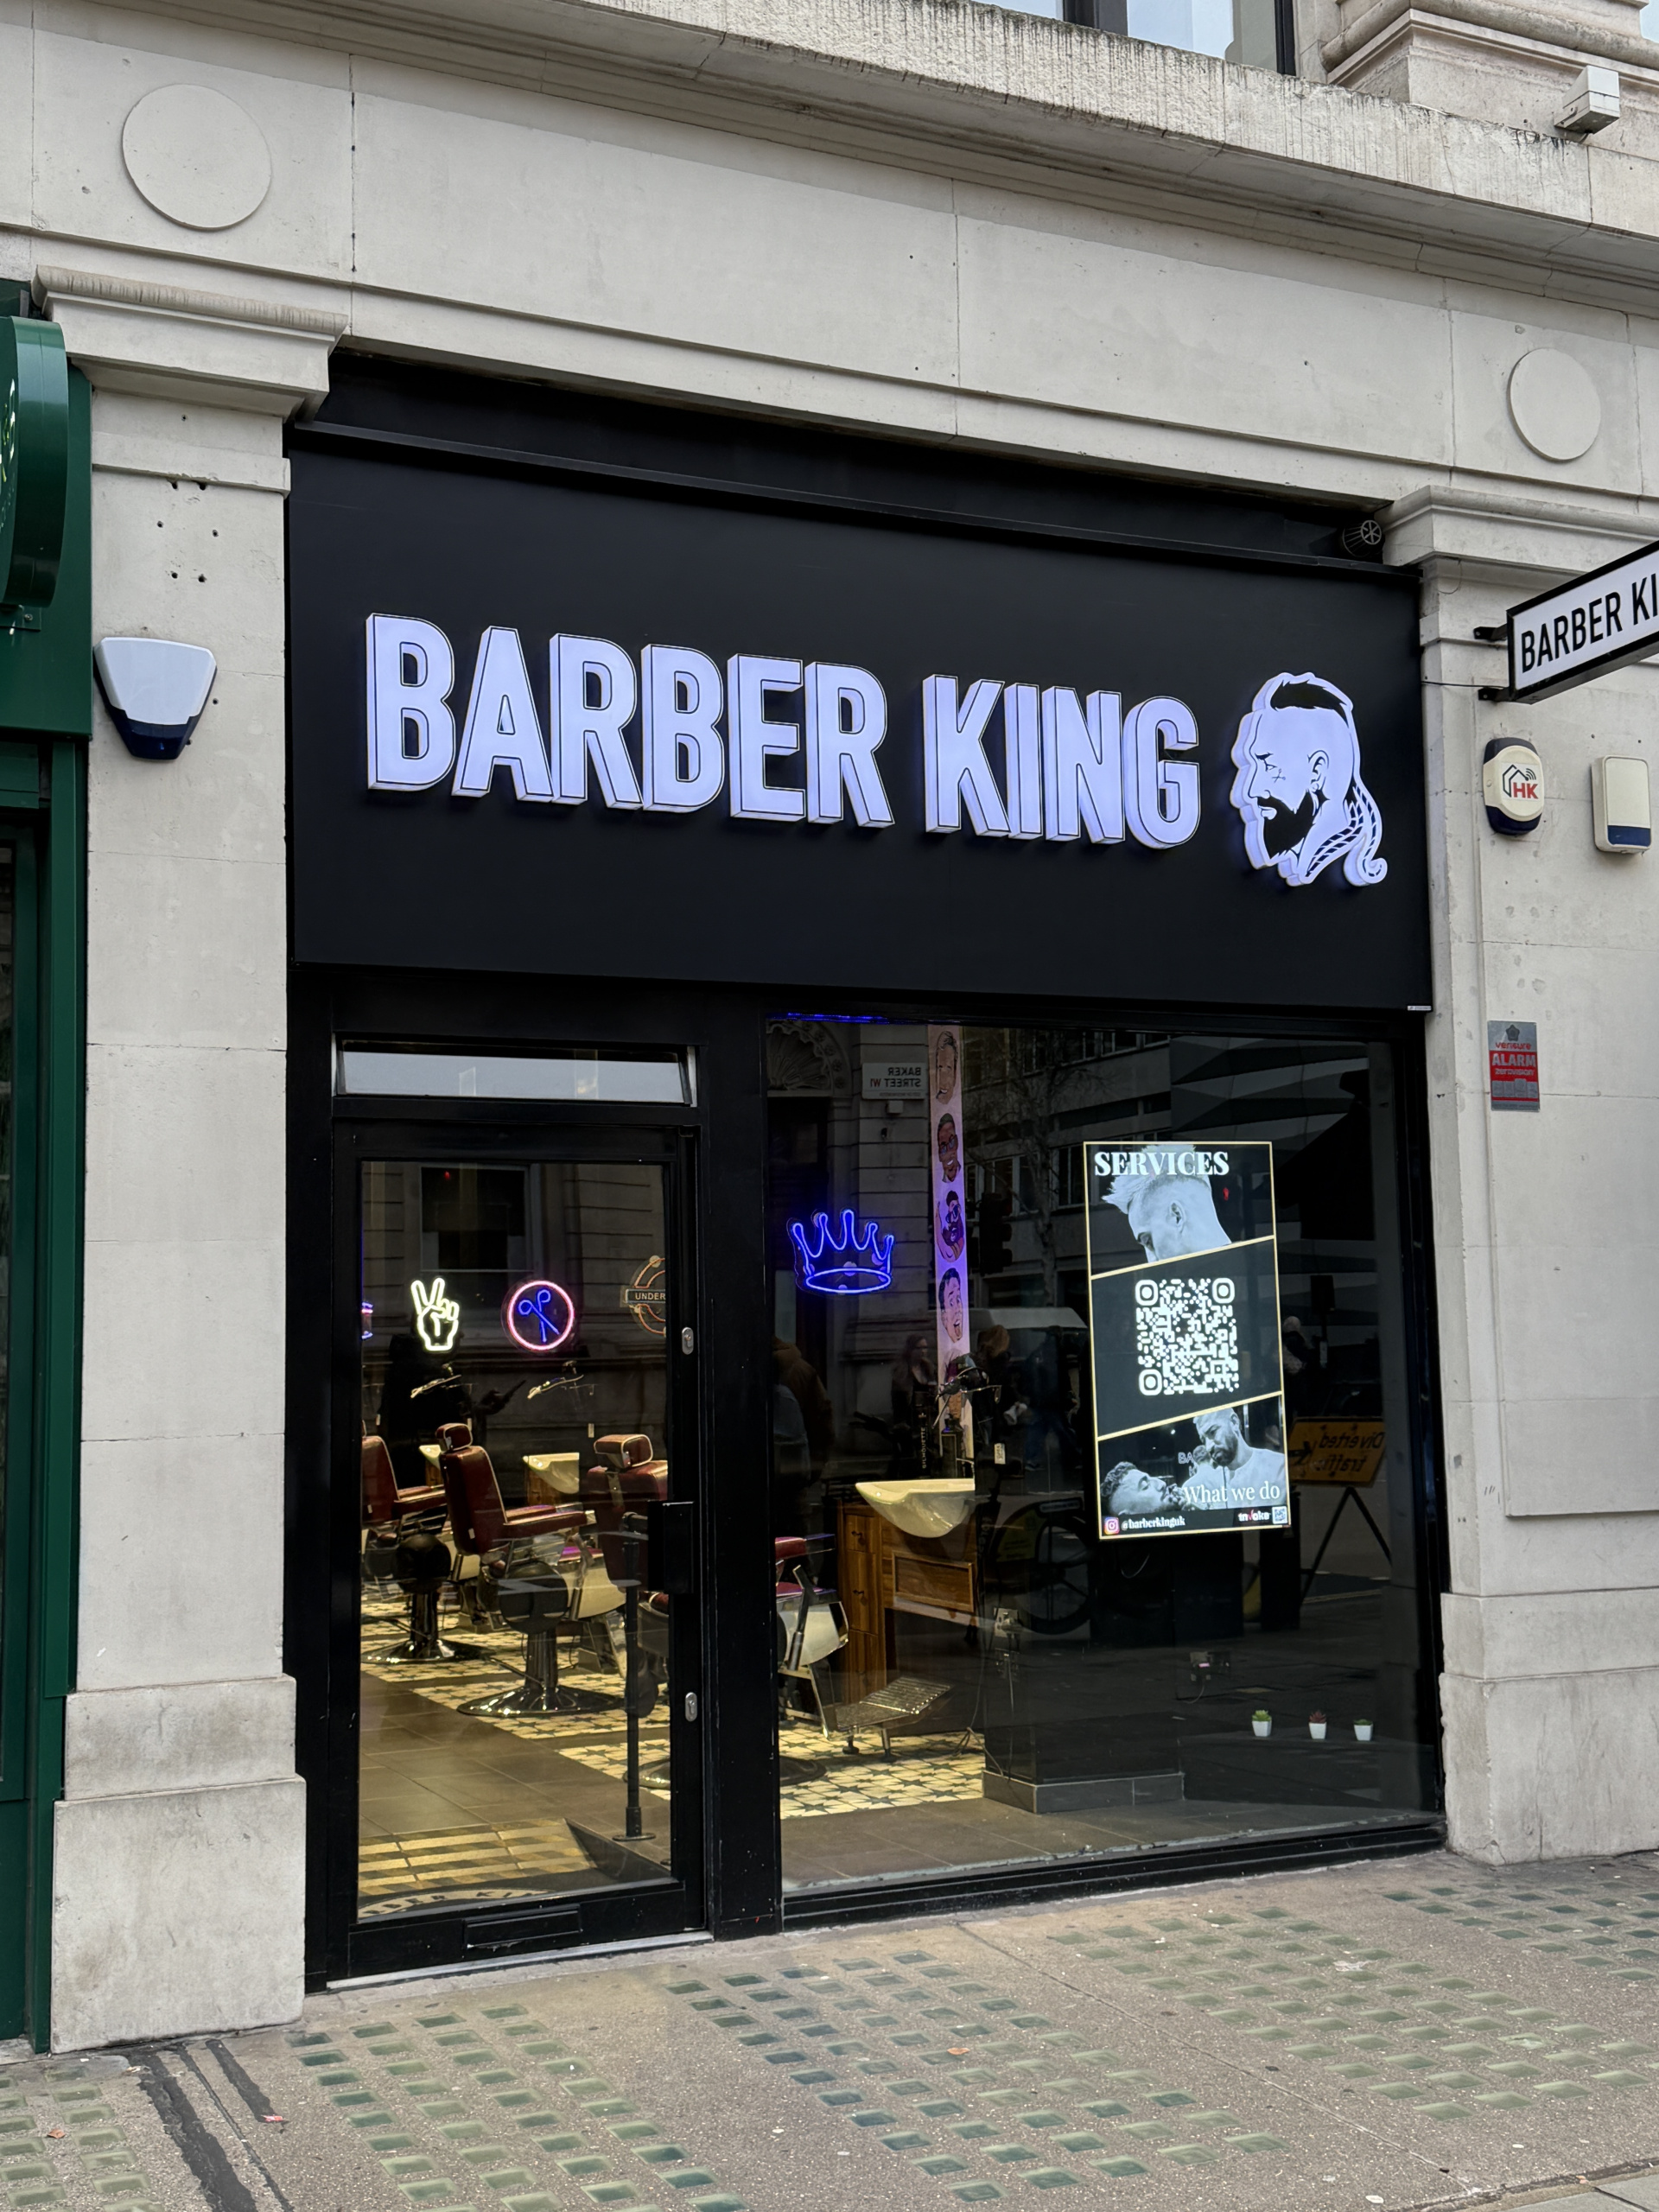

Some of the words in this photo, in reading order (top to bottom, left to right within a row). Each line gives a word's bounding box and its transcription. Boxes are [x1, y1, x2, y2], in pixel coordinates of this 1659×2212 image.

[1521, 592, 1623, 673] BARBER
[1631, 573, 1658, 626] KI
[366, 613, 895, 828] BARBER
[923, 674, 1201, 849] KING
[1513, 782, 1539, 799] HK
[1495, 1041, 1532, 1051] verisure
[1492, 1053, 1536, 1067] ALARM
[1094, 1151, 1230, 1176] SERVICES
[635, 1292, 665, 1300] UNDER
[1183, 1484, 1228, 1503] What
[1231, 1487, 1255, 1501] we
[1259, 1481, 1280, 1500] do
[1121, 1515, 1185, 1531] @barberkinguk
